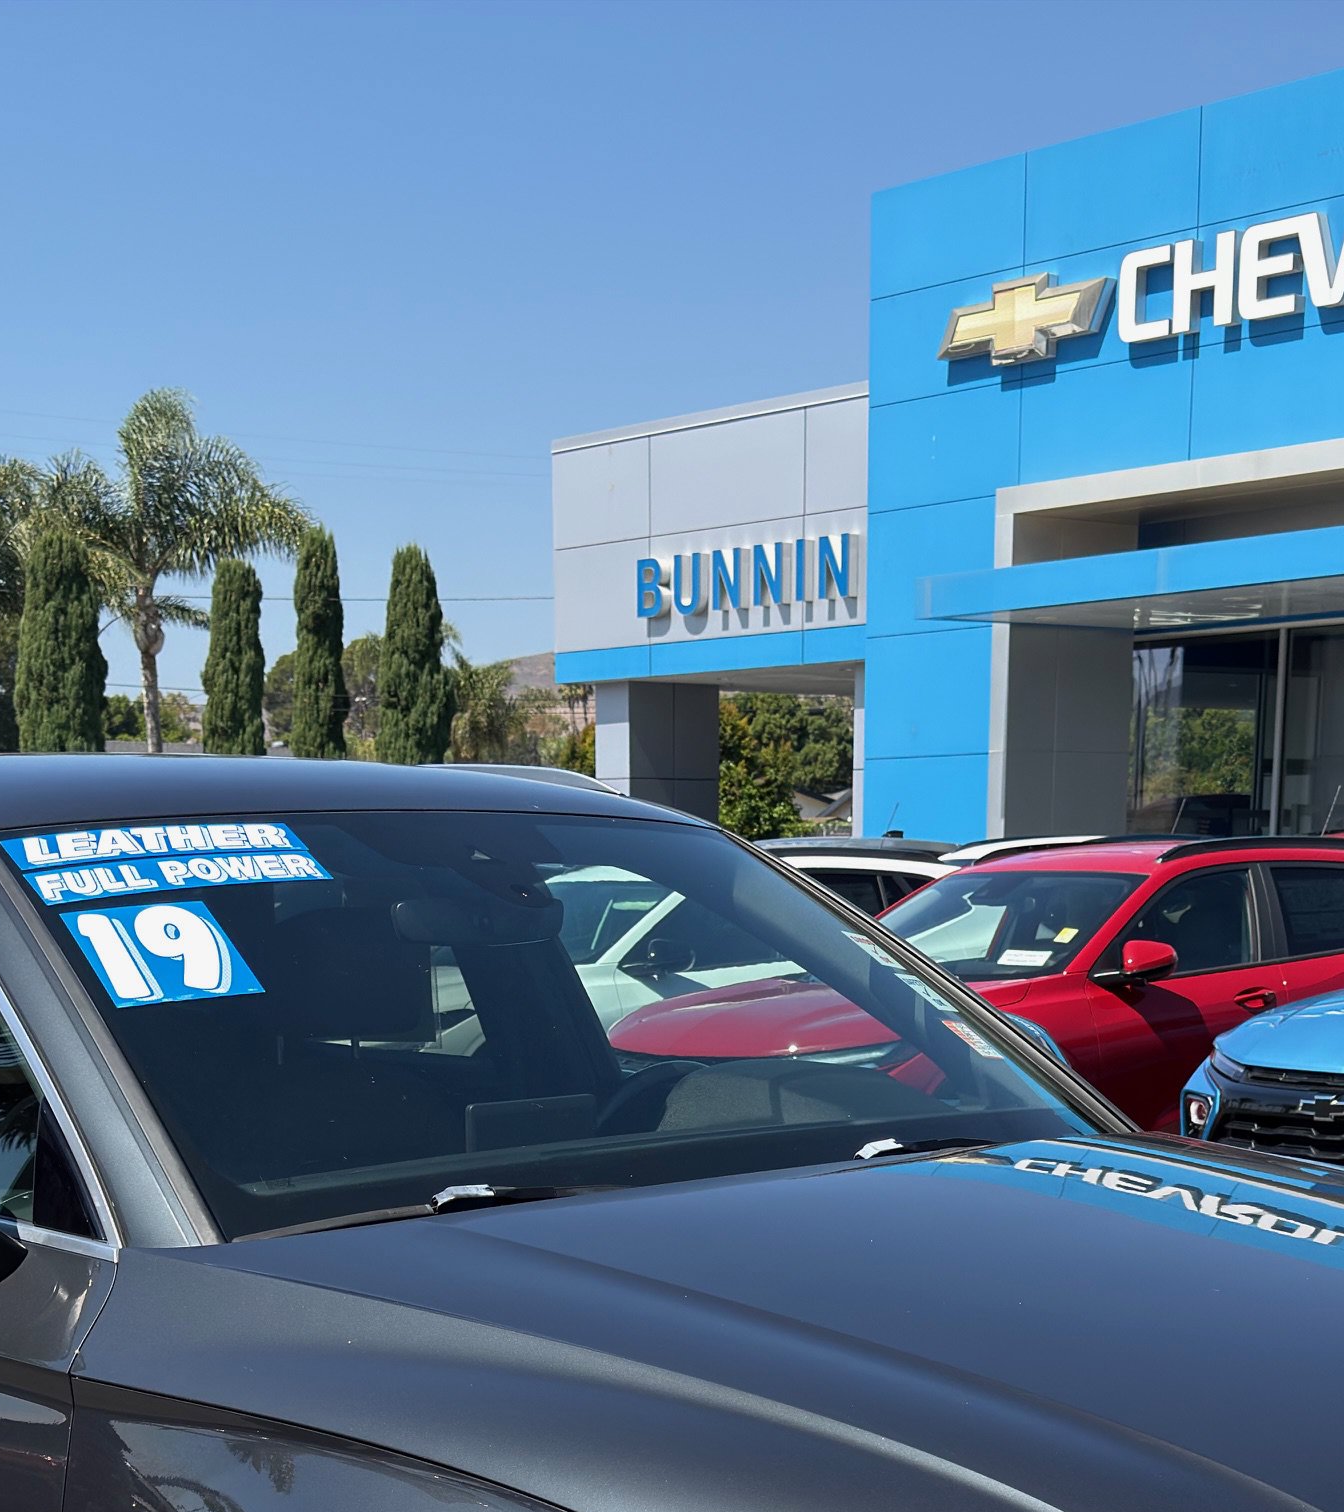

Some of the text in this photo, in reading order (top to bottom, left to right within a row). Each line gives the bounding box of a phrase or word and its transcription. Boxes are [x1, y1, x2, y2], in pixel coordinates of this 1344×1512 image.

[636, 532, 859, 618] BUNNIN
[22, 823, 293, 865] LEATHER
[34, 852, 319, 902] FULL POWER
[76, 905, 233, 1002] 19
